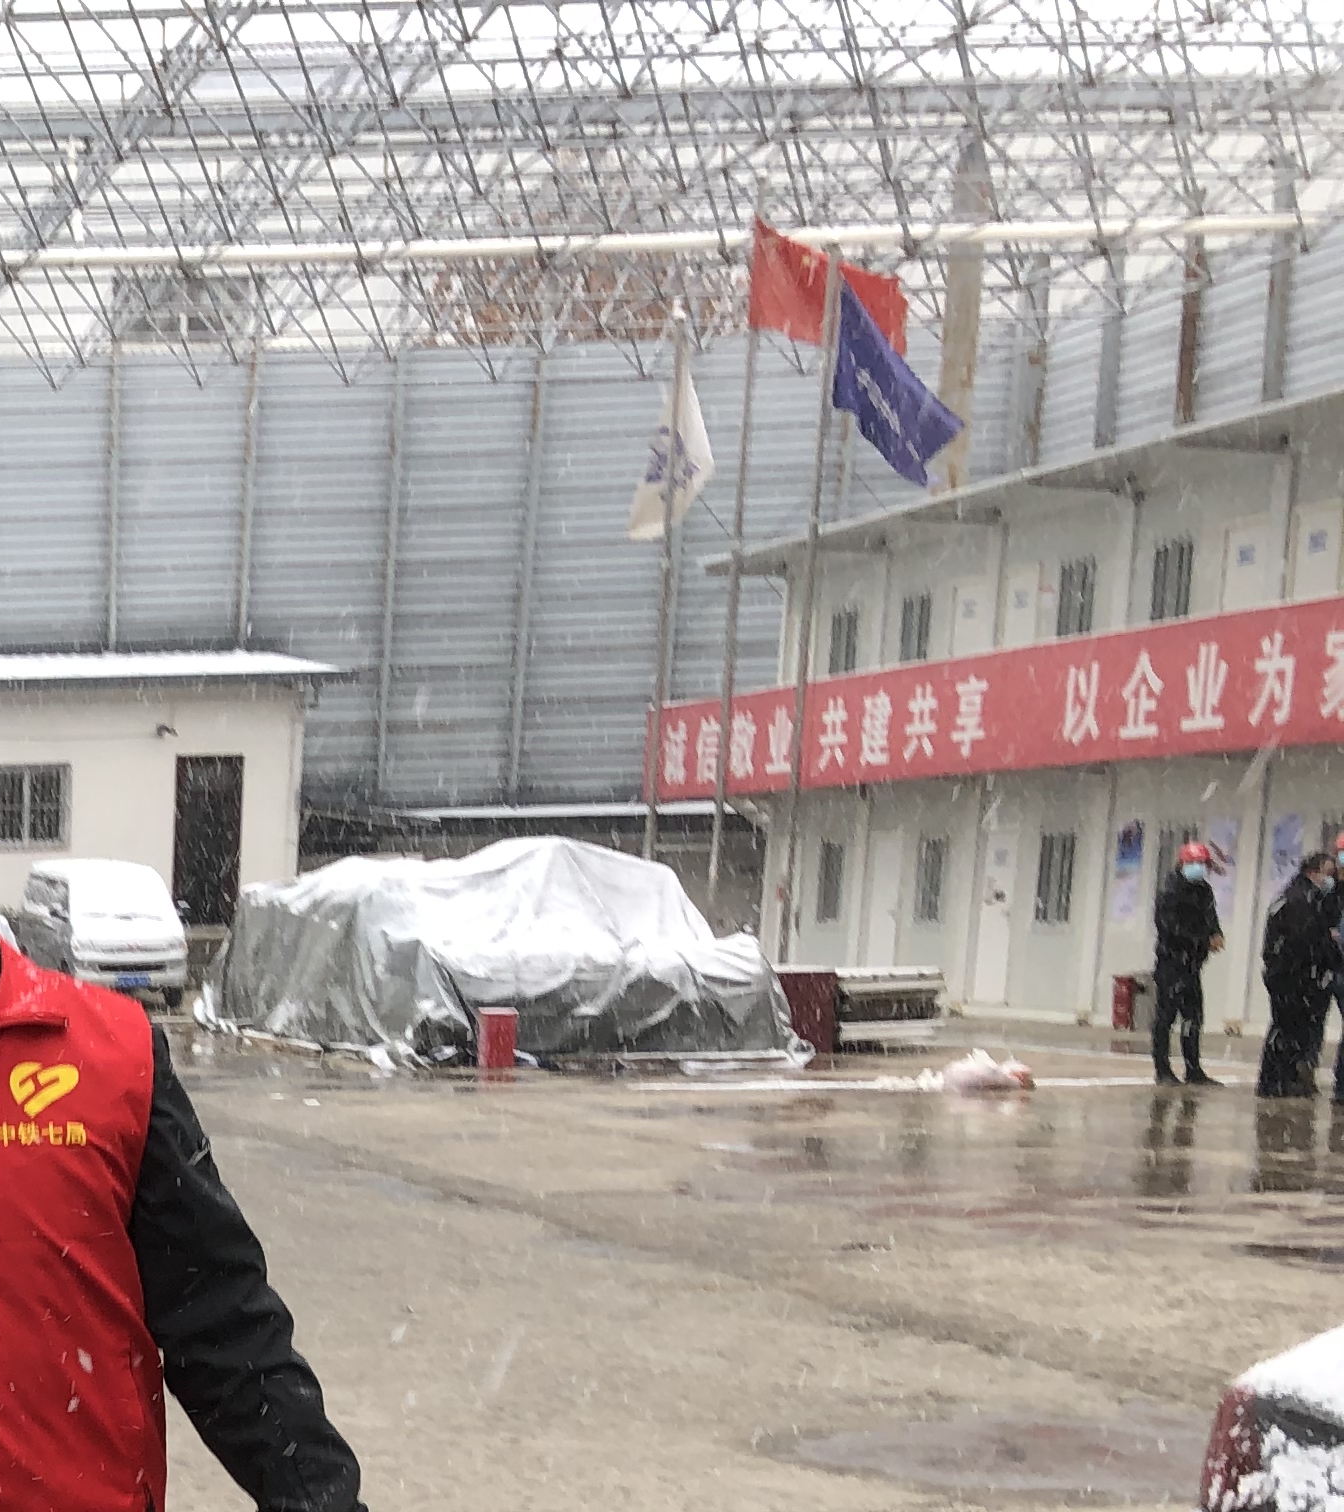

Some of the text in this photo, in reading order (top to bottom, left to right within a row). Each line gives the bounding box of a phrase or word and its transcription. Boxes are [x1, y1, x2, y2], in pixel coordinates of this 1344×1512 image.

[663, 704, 795, 785] 诚信敬业
[817, 674, 990, 771] 共建共享
